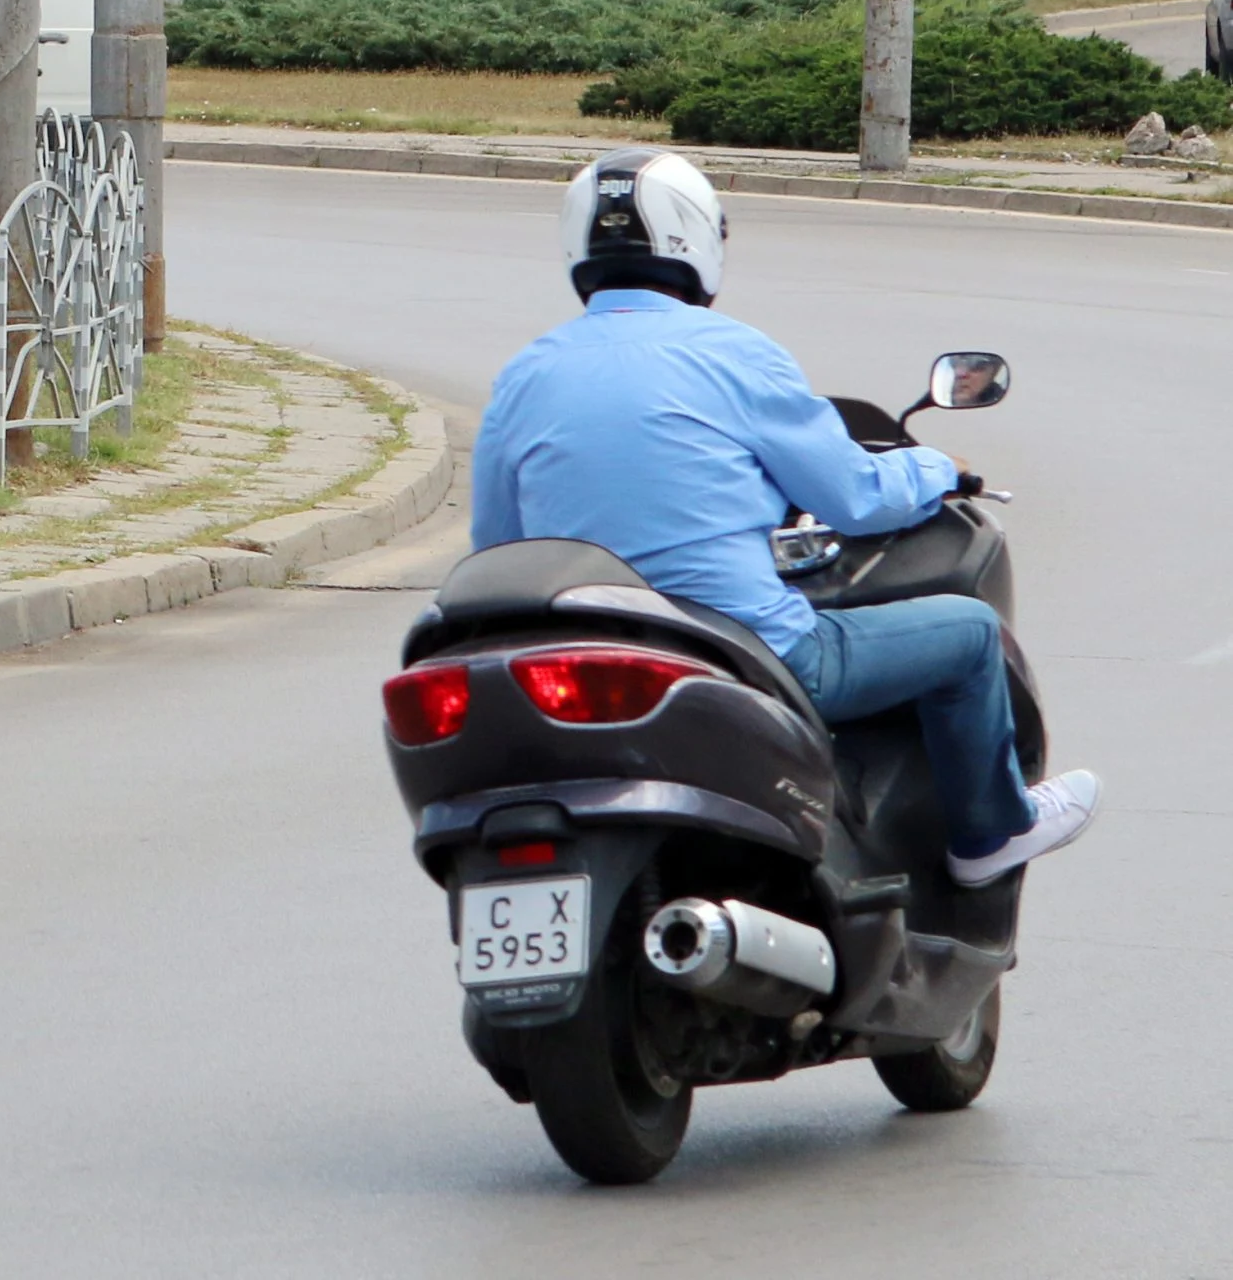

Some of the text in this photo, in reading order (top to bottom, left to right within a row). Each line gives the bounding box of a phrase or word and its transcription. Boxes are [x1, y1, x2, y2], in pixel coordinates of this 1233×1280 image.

[598, 179, 634, 198] agv
[490, 890, 570, 929] C X
[475, 931, 568, 971] 5953
